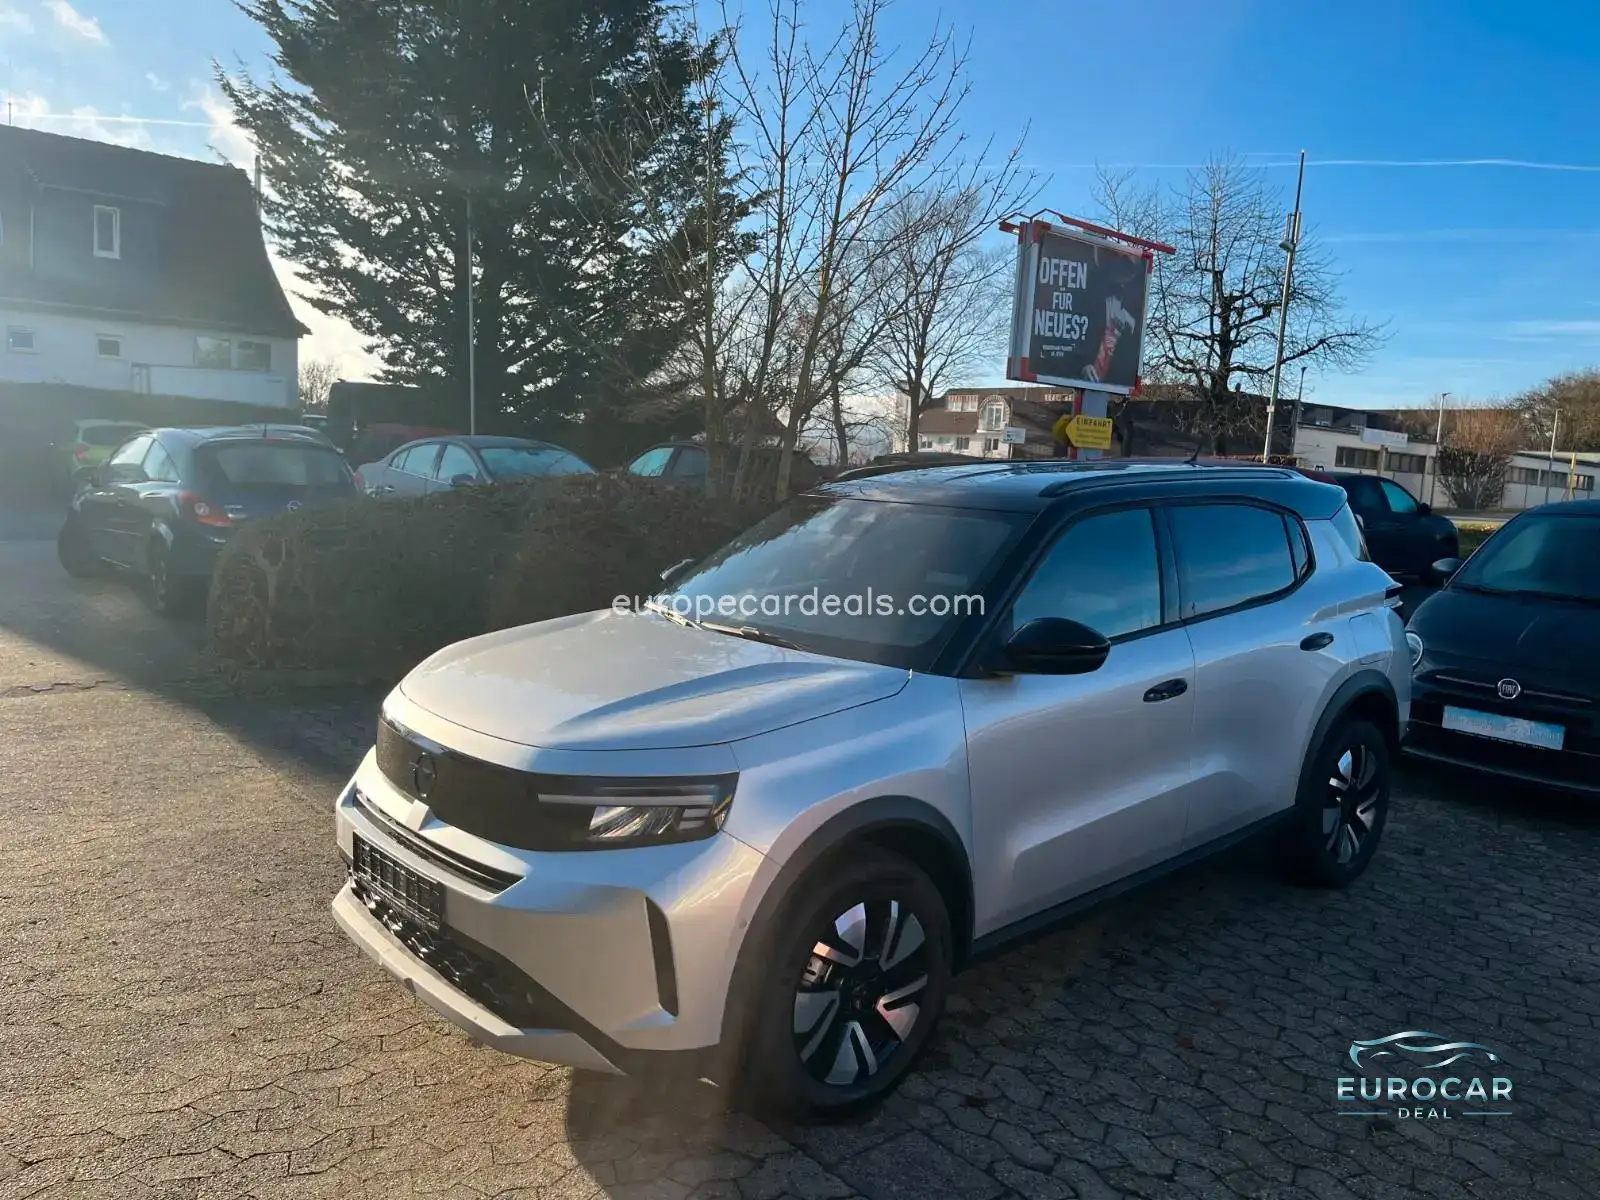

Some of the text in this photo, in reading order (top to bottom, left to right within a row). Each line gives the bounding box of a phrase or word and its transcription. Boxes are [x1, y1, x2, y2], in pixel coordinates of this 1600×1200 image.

[1039, 258, 1088, 290] OFFEN
[1052, 288, 1073, 312] FÜR
[1034, 308, 1089, 341] NEUES?
[1076, 416, 1112, 428] EINFAHRT
